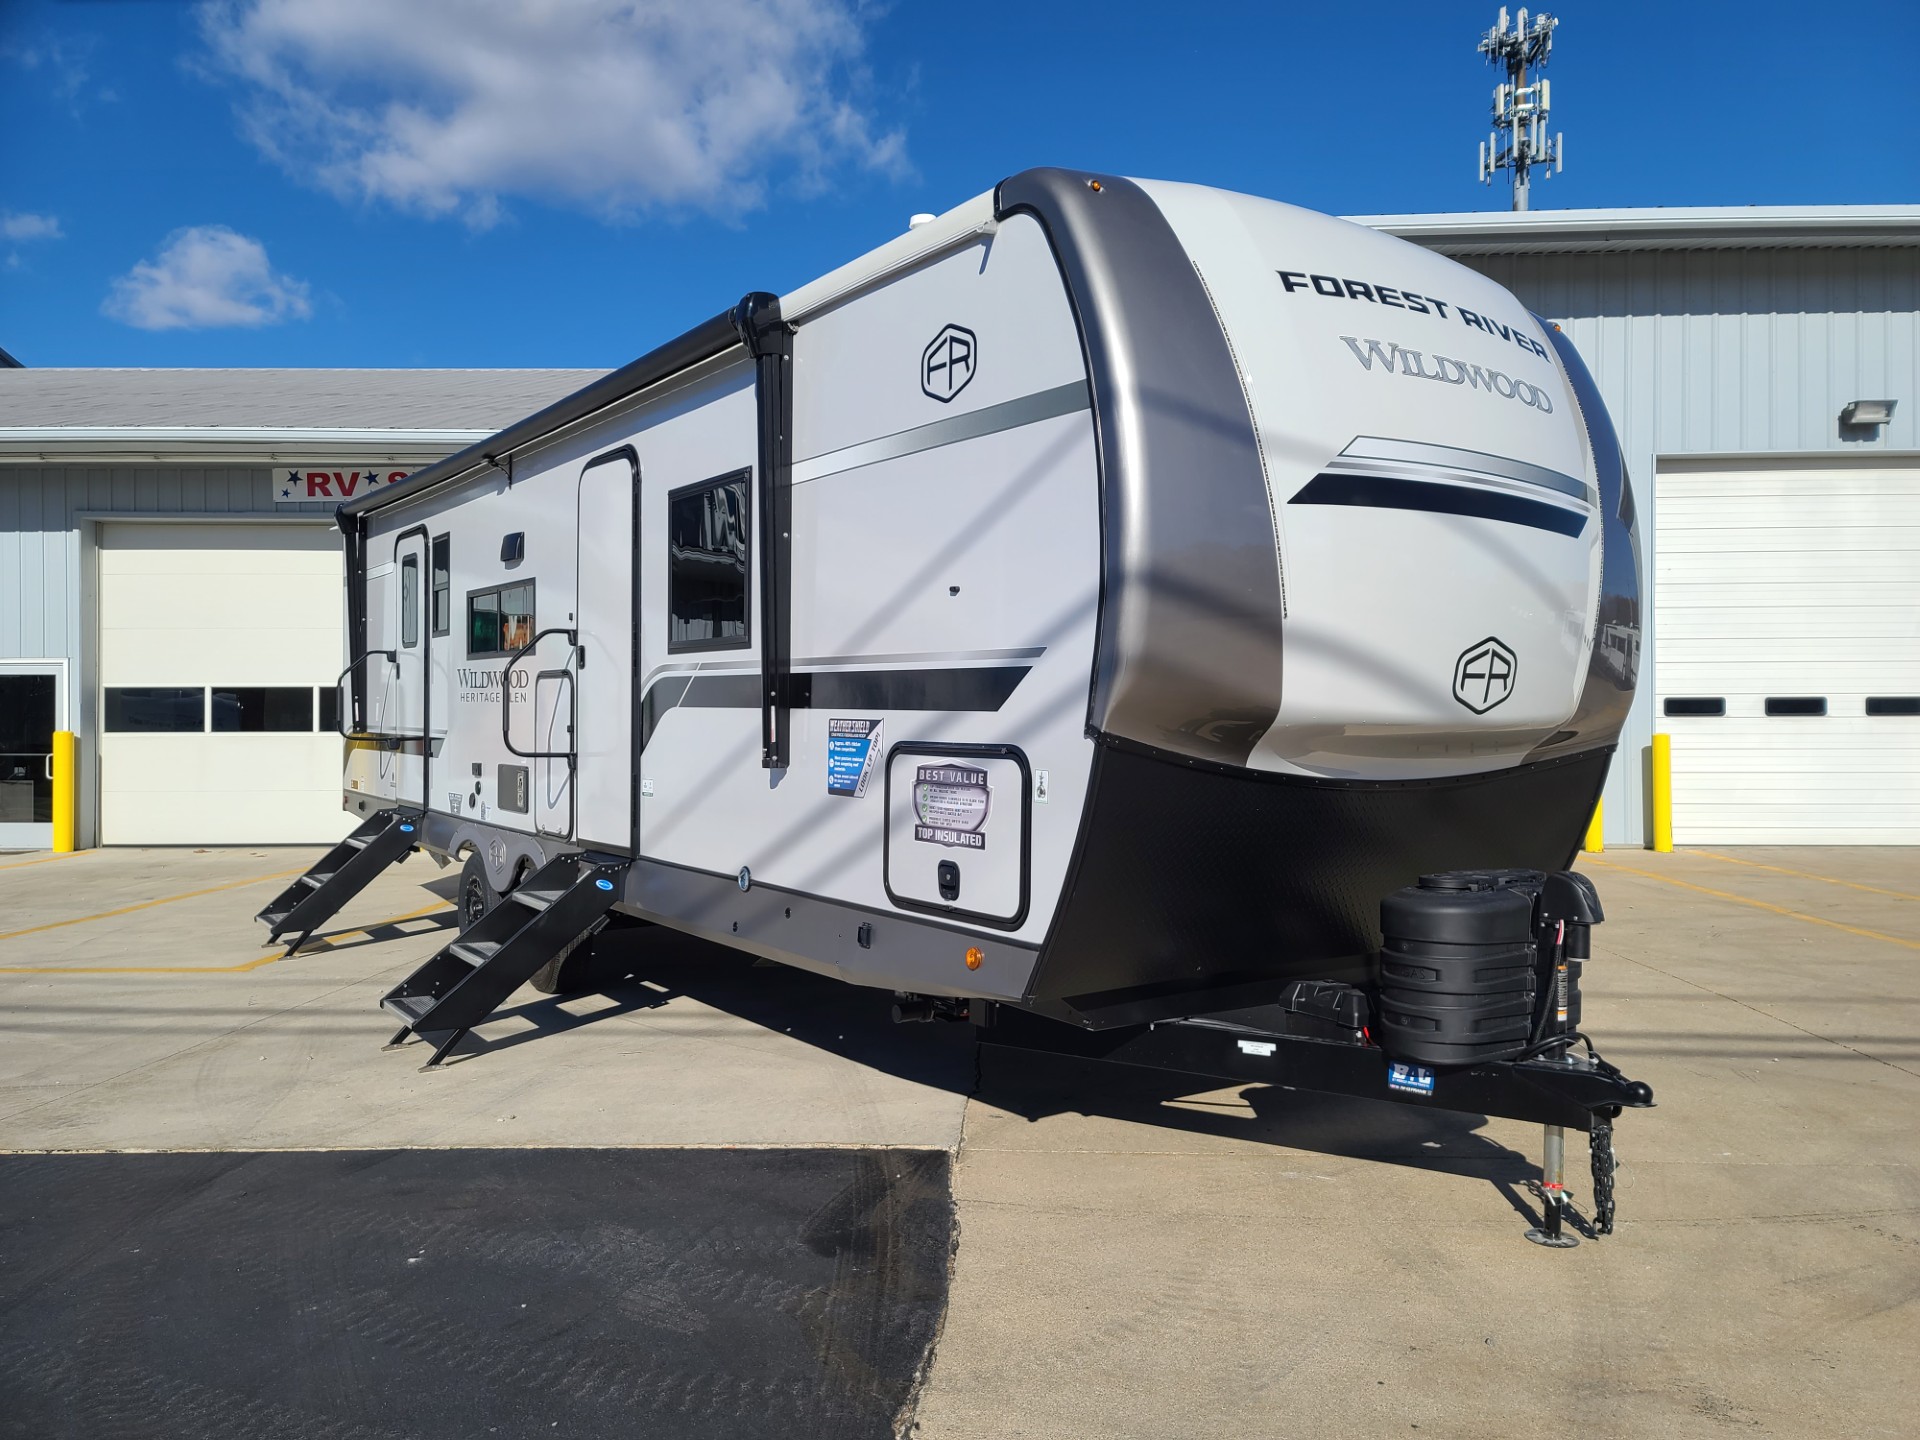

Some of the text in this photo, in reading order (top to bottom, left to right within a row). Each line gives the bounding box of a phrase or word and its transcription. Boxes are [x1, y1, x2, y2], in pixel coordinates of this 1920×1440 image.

[1276, 269, 1552, 364] FOREST RIVER
[306, 471, 361, 497] RV
[460, 692, 528, 703] HERITAGE LEN
[858, 769, 869, 793] LOOK
[919, 769, 985, 785] BEST VALUE
[917, 827, 982, 847] TOP INSULATED
